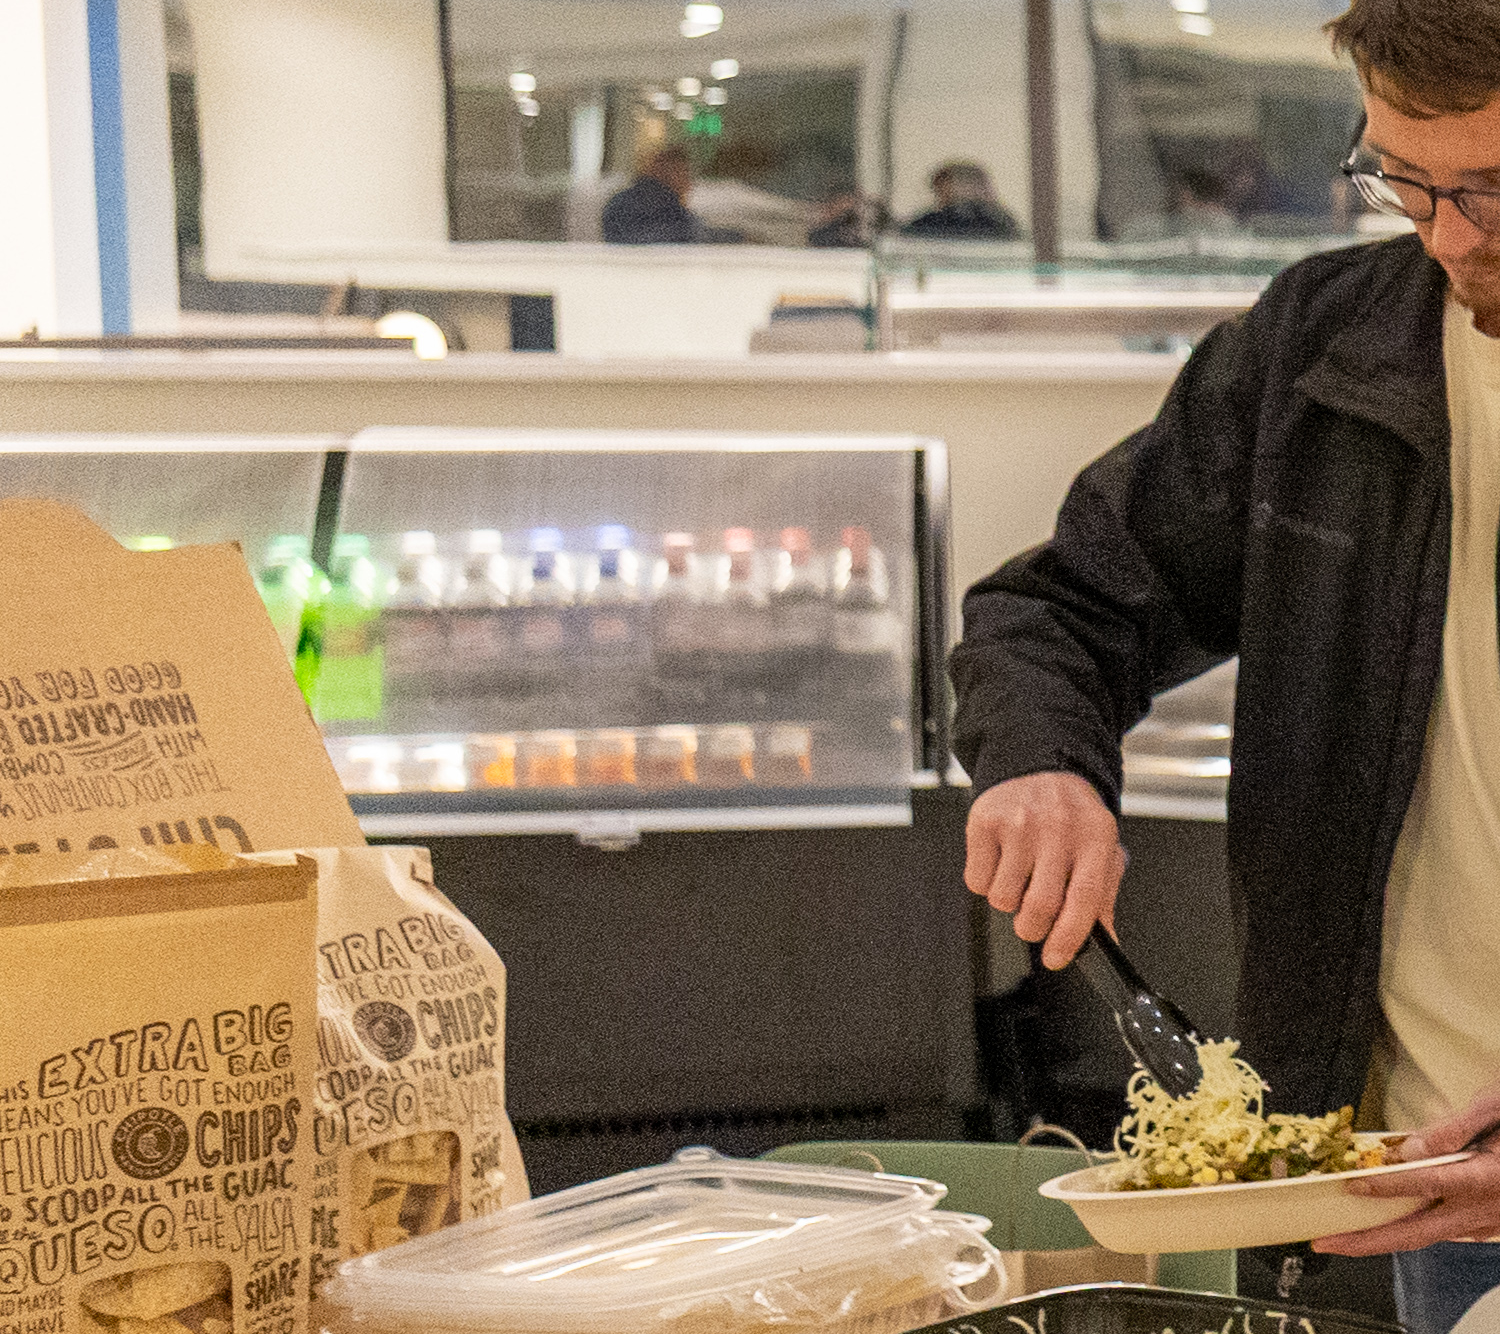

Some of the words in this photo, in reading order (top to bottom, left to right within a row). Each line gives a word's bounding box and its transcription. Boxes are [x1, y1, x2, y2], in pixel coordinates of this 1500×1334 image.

[36, 666, 99, 703] FOR
[103, 660, 182, 695] GOOD
[154, 728, 208, 759] WITH
[0, 750, 65, 781] COMBI
[172, 760, 231, 795] THIS
[14, 774, 128, 821] CONTAINS
[319, 928, 411, 979] TRA
[399, 913, 465, 954] BIG
[423, 942, 474, 971] BAG
[374, 973, 415, 999] GOT
[418, 965, 487, 995] ENOUGH
[416, 986, 498, 1050] CHIPS
[0, 1080, 29, 1103] HIS
[38, 1017, 209, 1099] EXTRA
[212, 1002, 293, 1056] BIG
[228, 1044, 291, 1077] BAG
[0, 1101, 64, 1133] EANS
[71, 1077, 148, 1118] YOU'VE
[160, 1075, 206, 1107] GOT
[212, 1072, 295, 1105] ENOUGH
[317, 1064, 373, 1103] COOP
[0, 1120, 108, 1196] ELICIOUS
[195, 1097, 301, 1169] CHIPS
[24, 1184, 116, 1227] SCOOP
[120, 1185, 160, 1206] ALL
[165, 1175, 214, 1199] THE
[183, 1197, 223, 1223] ALL
[184, 1220, 225, 1249] THE
[230, 1196, 300, 1262] SALSA
